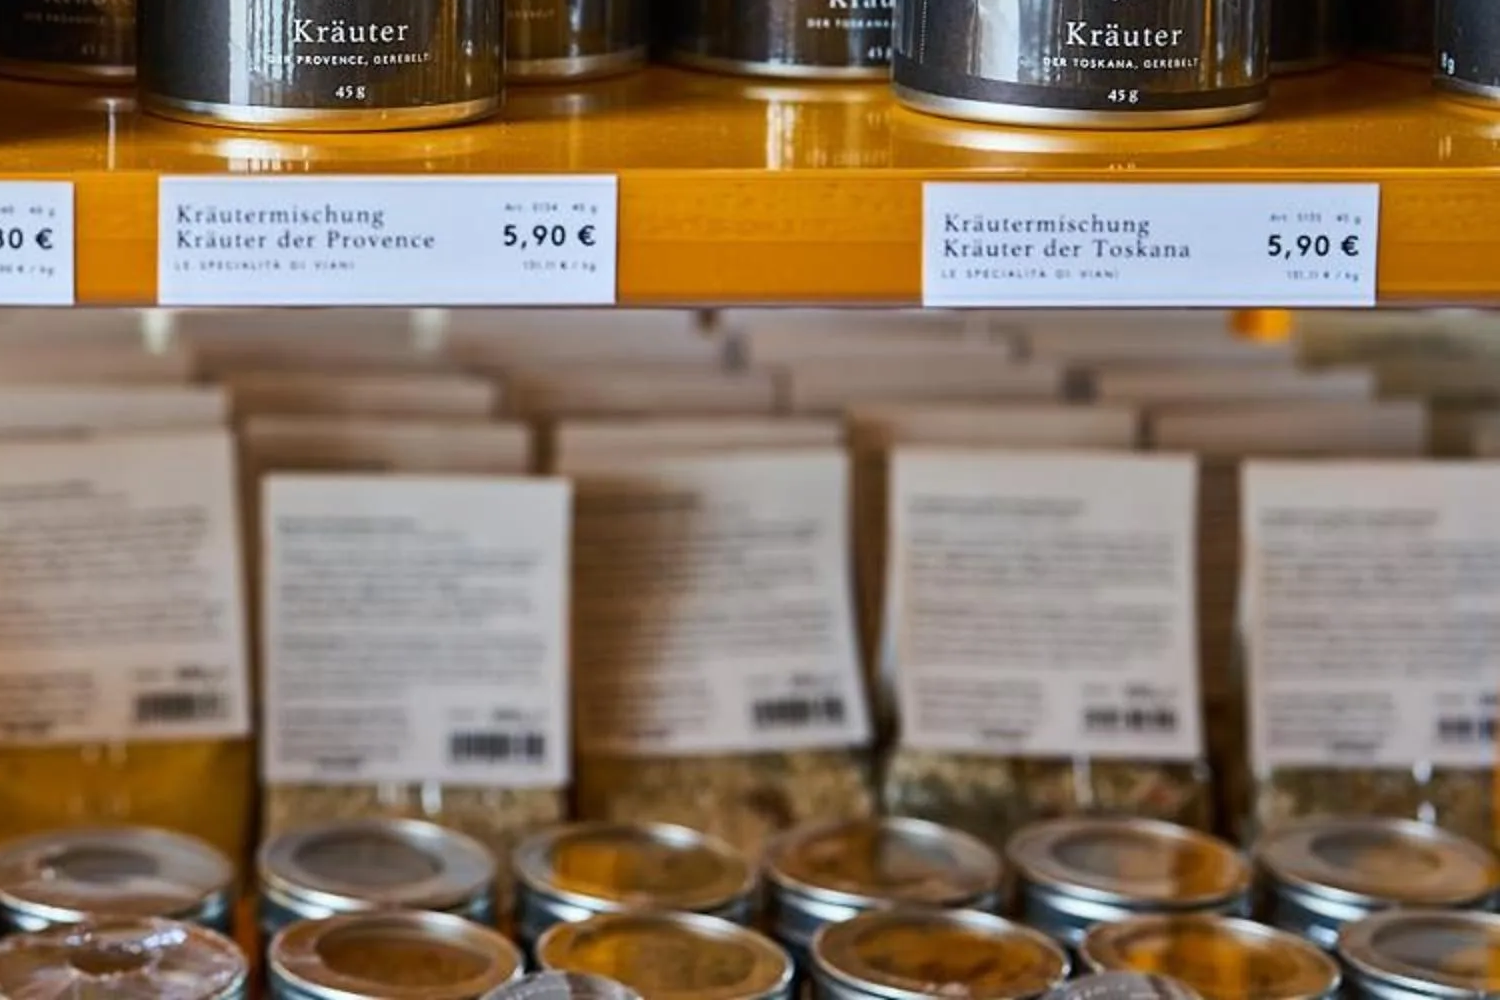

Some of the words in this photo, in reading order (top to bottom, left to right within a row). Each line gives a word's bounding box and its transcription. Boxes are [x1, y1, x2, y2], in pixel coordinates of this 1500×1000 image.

[293, 19, 410, 44] Kräuter
[1065, 20, 1184, 47] Kräuter
[296, 55, 369, 67] PROVENCE,
[1073, 58, 1138, 71] TOSKANA,
[335, 85, 353, 99] 45
[1107, 89, 1126, 103] 45
[1128, 90, 1140, 104] g
[176, 203, 386, 229] Kräutermischung
[943, 212, 1151, 238] Kräutermischung
[35, 227, 54, 251] €
[176, 230, 268, 250] Kräuter
[275, 229, 315, 250] der
[326, 230, 436, 250] Provence
[503, 223, 567, 251] 5,90
[577, 223, 597, 247] €
[943, 238, 1035, 258] Kräuter
[1042, 238, 1083, 258] der
[1091, 238, 1191, 259] Toskana
[1267, 233, 1331, 260] 5,90
[1340, 234, 1360, 257] €
